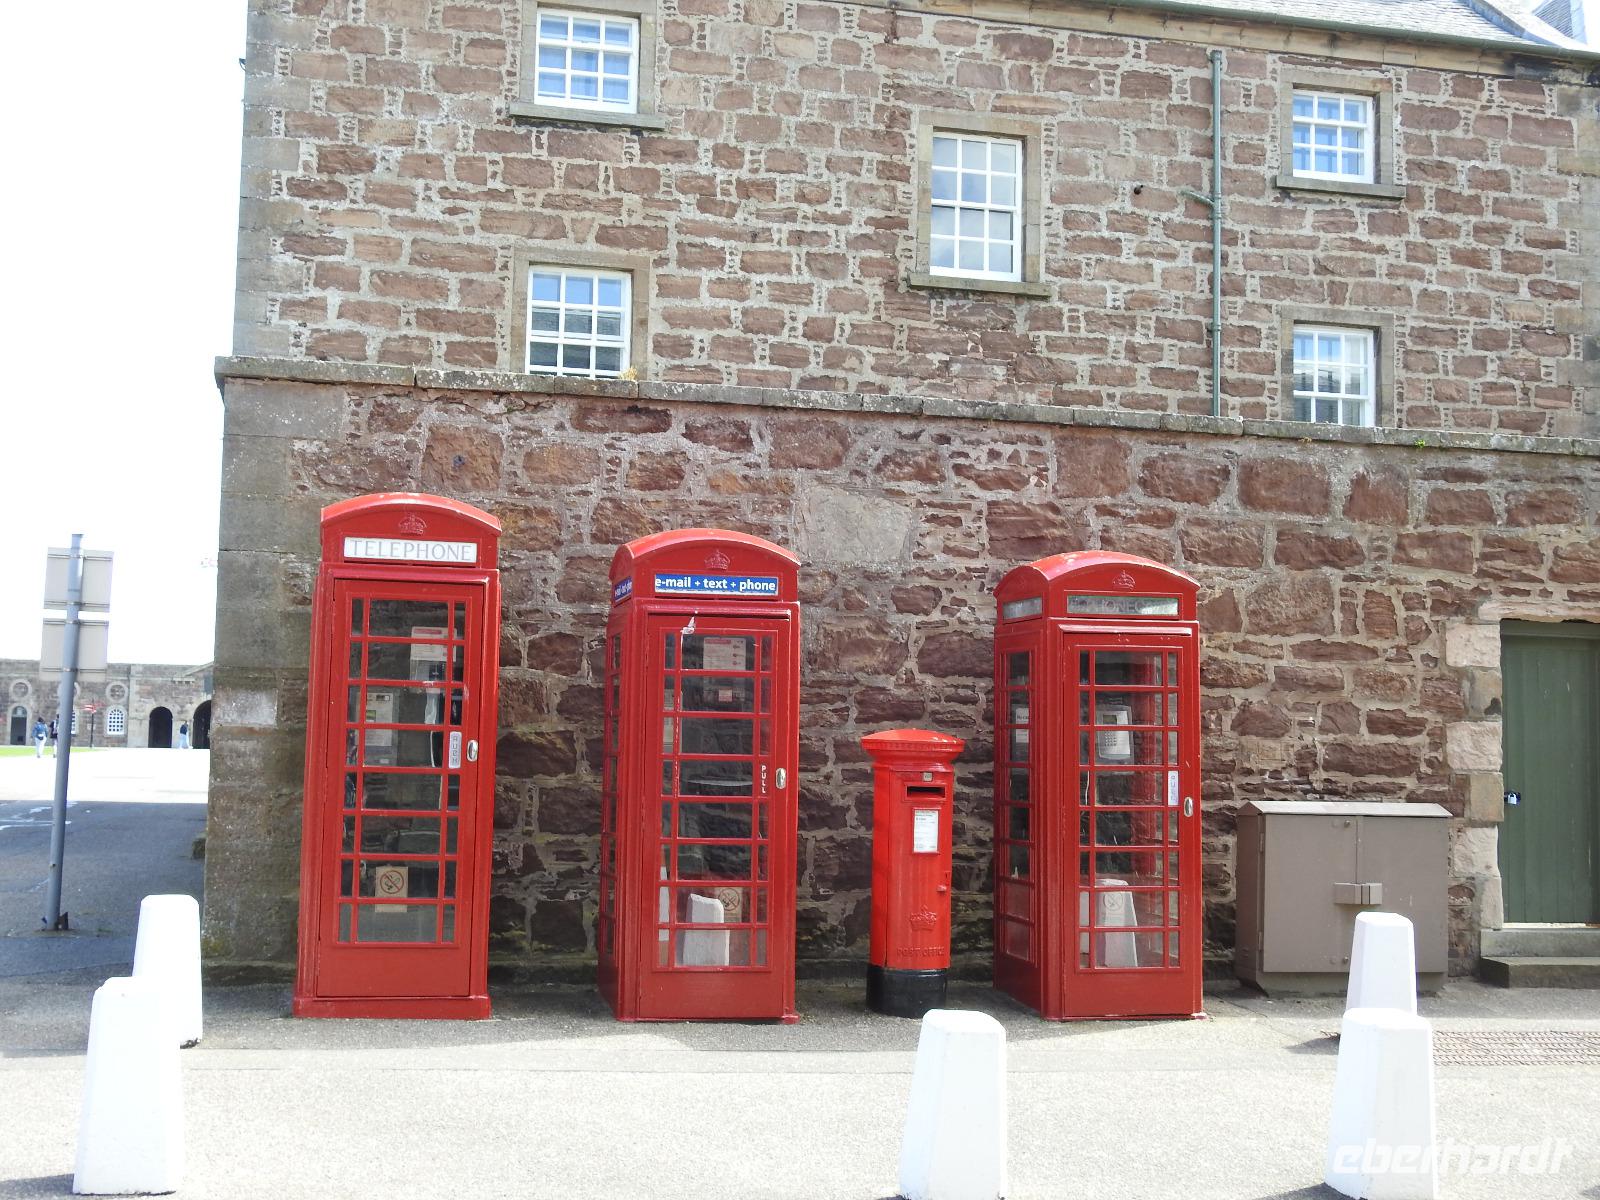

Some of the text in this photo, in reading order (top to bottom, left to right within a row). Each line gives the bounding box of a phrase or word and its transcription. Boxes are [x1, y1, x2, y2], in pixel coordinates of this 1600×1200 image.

[350, 539, 472, 561] TELEPHONE
[655, 576, 691, 588] e-mail
[703, 577, 727, 589] text
[739, 578, 776, 592] phone
